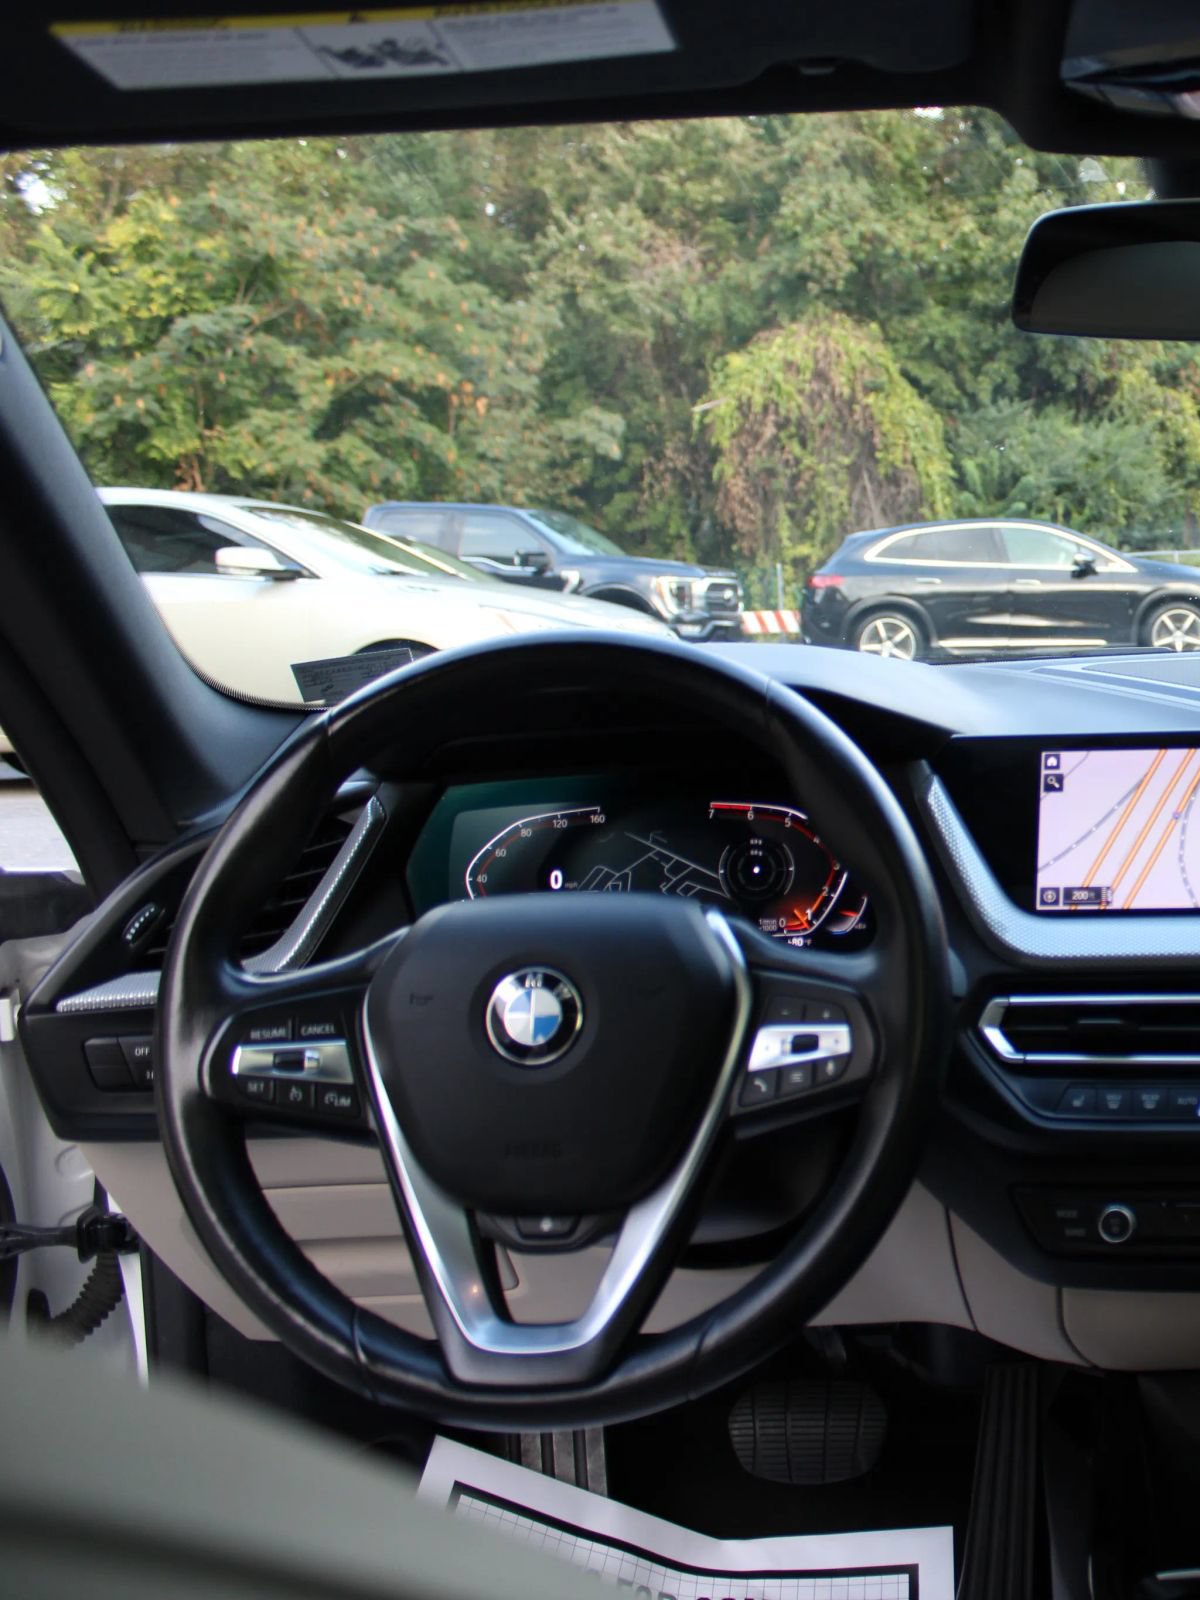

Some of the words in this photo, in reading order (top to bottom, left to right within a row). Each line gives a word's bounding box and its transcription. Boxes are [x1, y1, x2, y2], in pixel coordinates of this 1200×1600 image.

[590, 814, 605, 824] 160
[708, 809, 715, 819] 7
[747, 811, 754, 821] 6
[553, 819, 568, 829] 120
[784, 817, 792, 828] 5
[520, 828, 532, 838] 80
[495, 849, 507, 858] 60
[476, 874, 488, 884] 40
[550, 869, 563, 890] 0
[822, 886, 829, 897] 2
[1071, 891, 1089, 900] 200
[805, 908, 812, 921] 1
[778, 918, 787, 929] 0
[250, 1026, 288, 1040] RESUME
[300, 1023, 336, 1037] CANCEL
[134, 1046, 150, 1057] OFF
[247, 1081, 265, 1093] SET
[334, 1096, 352, 1107] LIM
